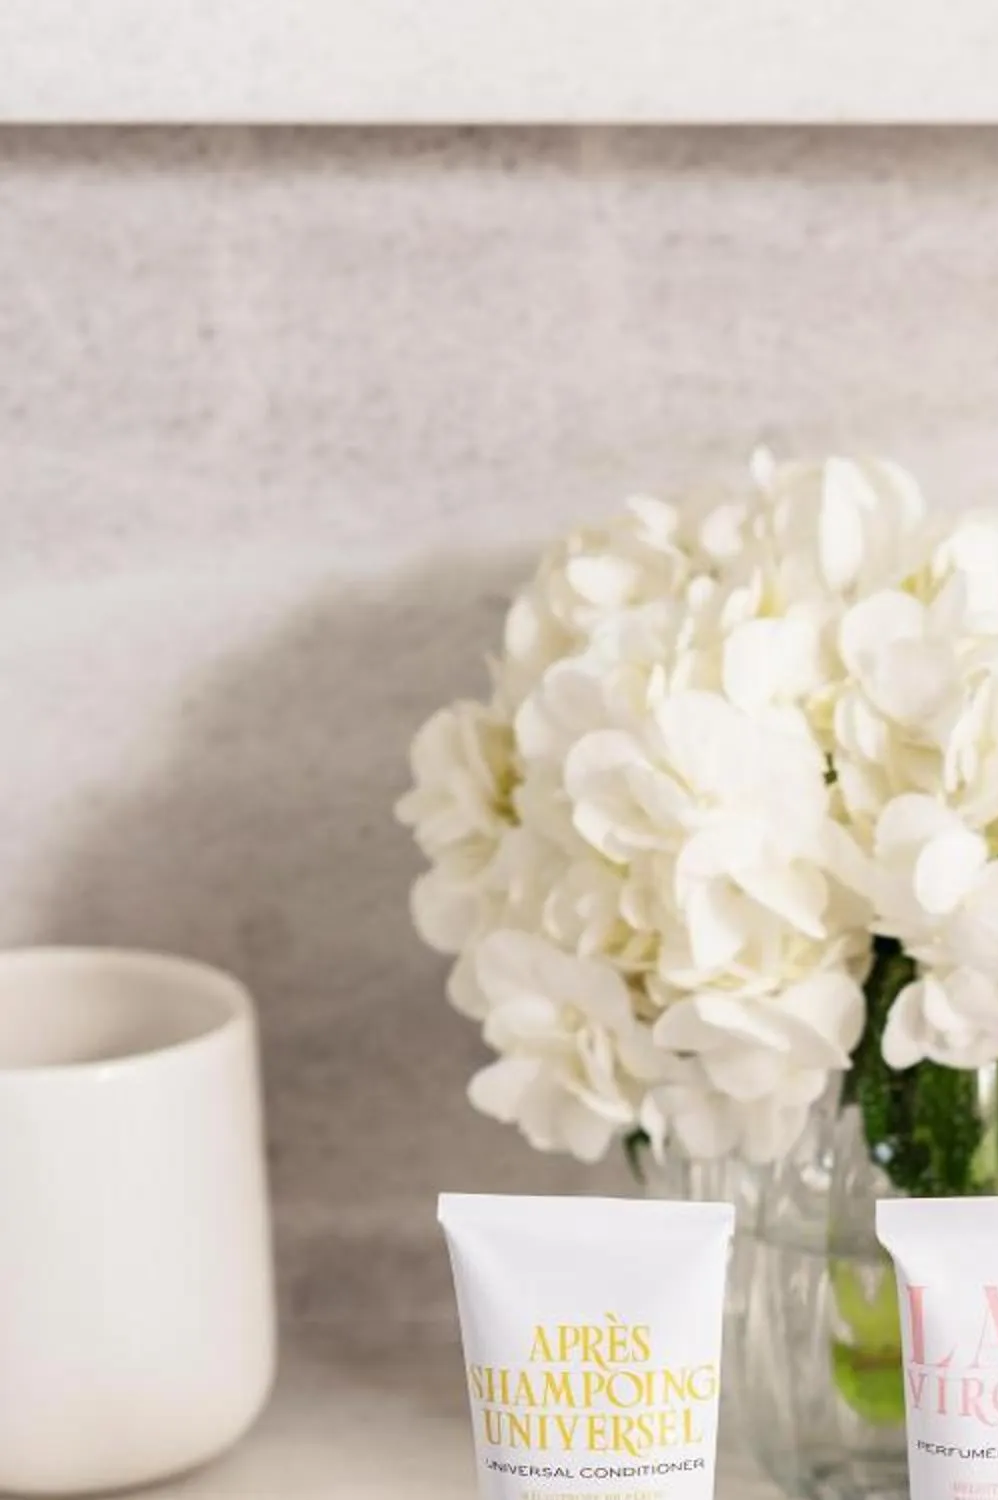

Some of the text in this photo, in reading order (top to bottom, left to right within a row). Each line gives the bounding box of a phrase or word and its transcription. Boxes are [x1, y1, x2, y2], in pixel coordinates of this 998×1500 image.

[529, 1311, 651, 1371] APRÈS
[469, 1364, 716, 1409] SHAMPOING
[481, 1408, 702, 1456] UNIVERSEL
[486, 1458, 705, 1479] UNIVERSAL CONDITIONER
